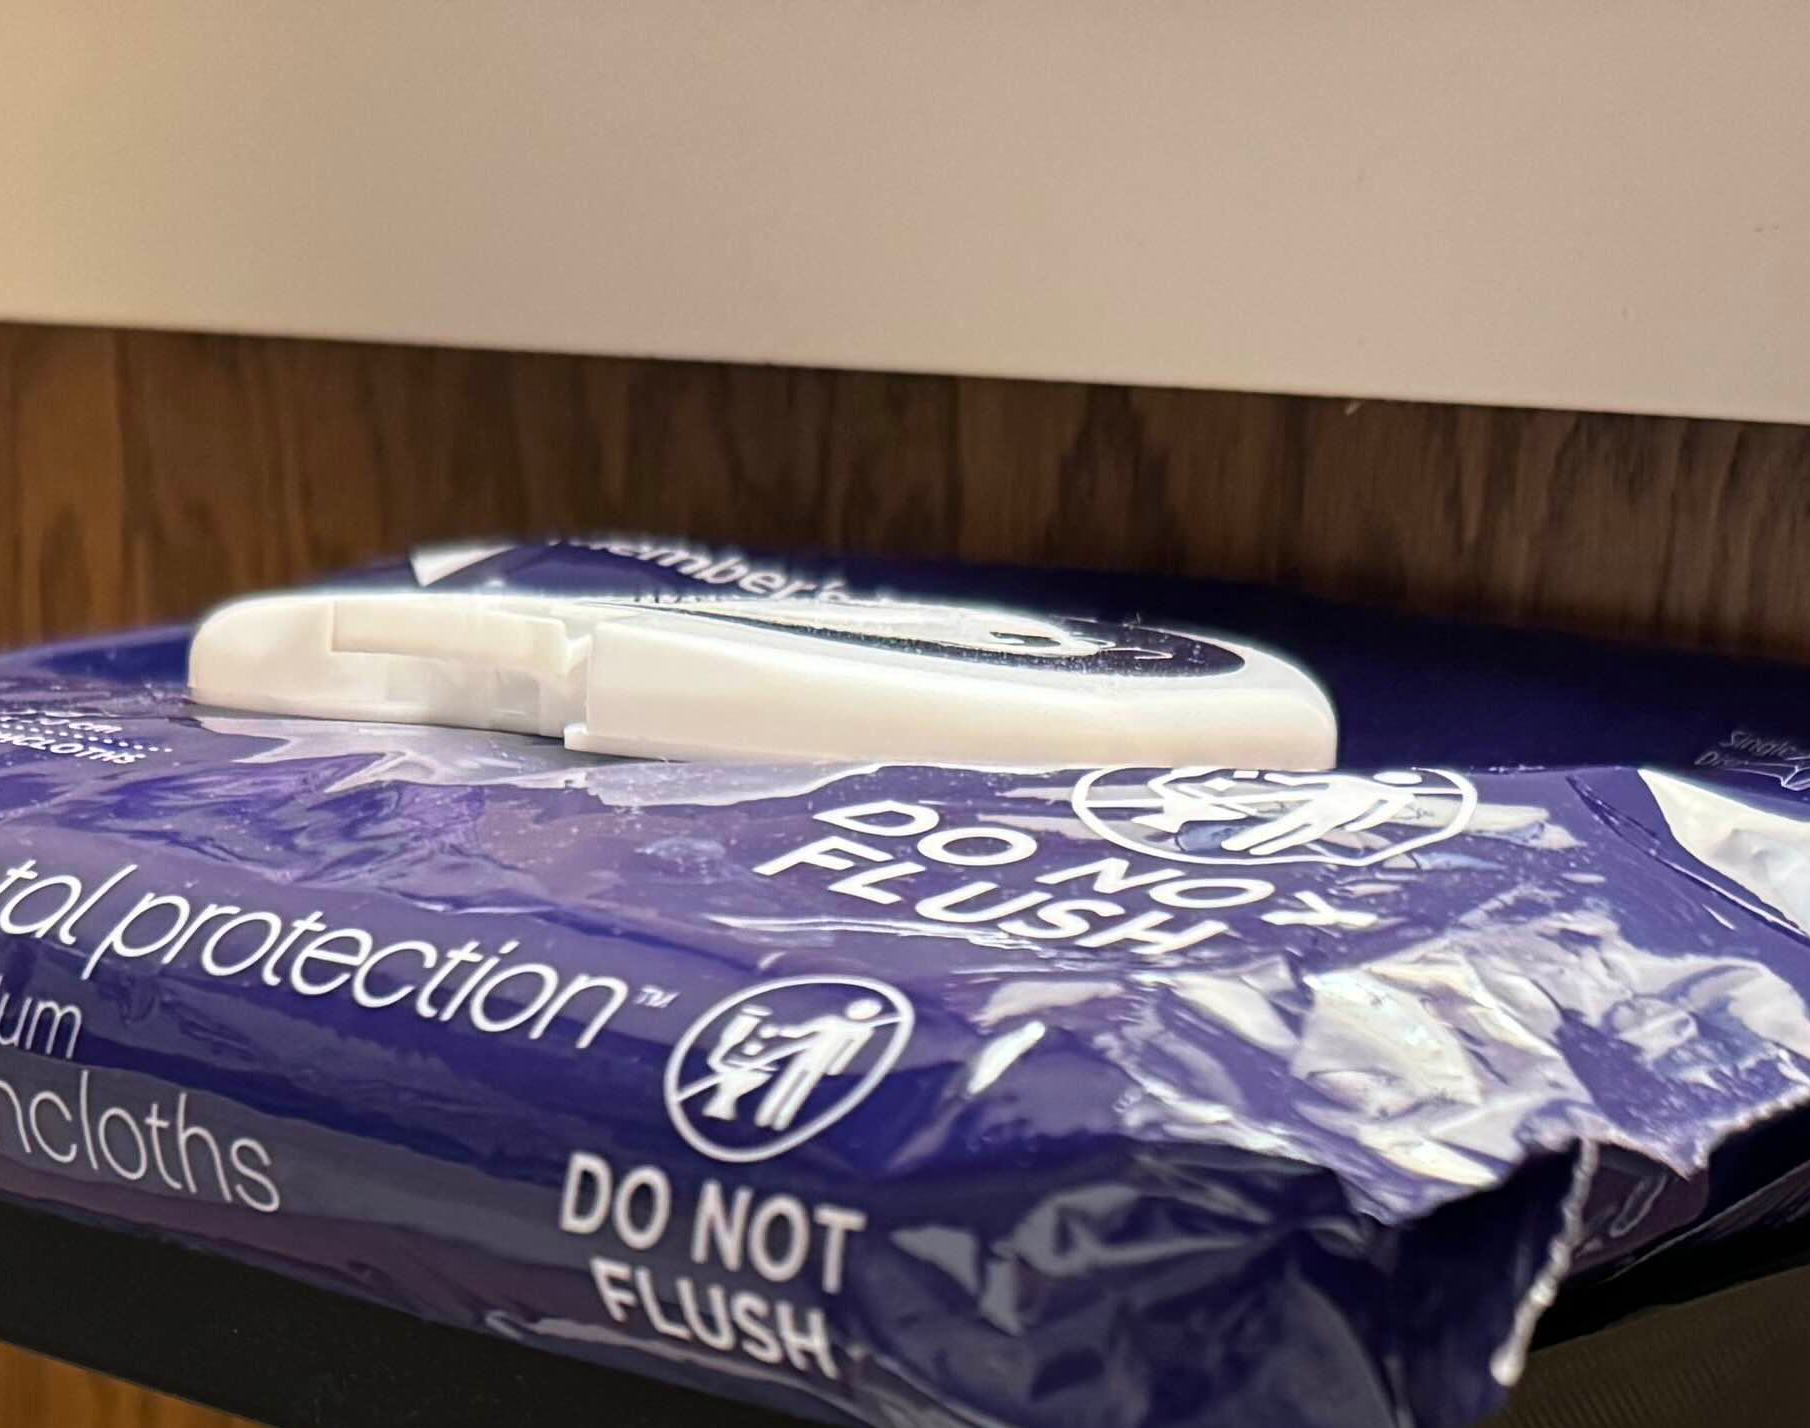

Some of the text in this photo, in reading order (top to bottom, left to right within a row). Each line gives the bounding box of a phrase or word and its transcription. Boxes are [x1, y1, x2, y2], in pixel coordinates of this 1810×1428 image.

[813, 799, 1038, 867] DO
[751, 835, 1231, 957] FLUSH
[560, 1152, 868, 1294] DO NOT
[589, 1257, 842, 1381] FLUSH
